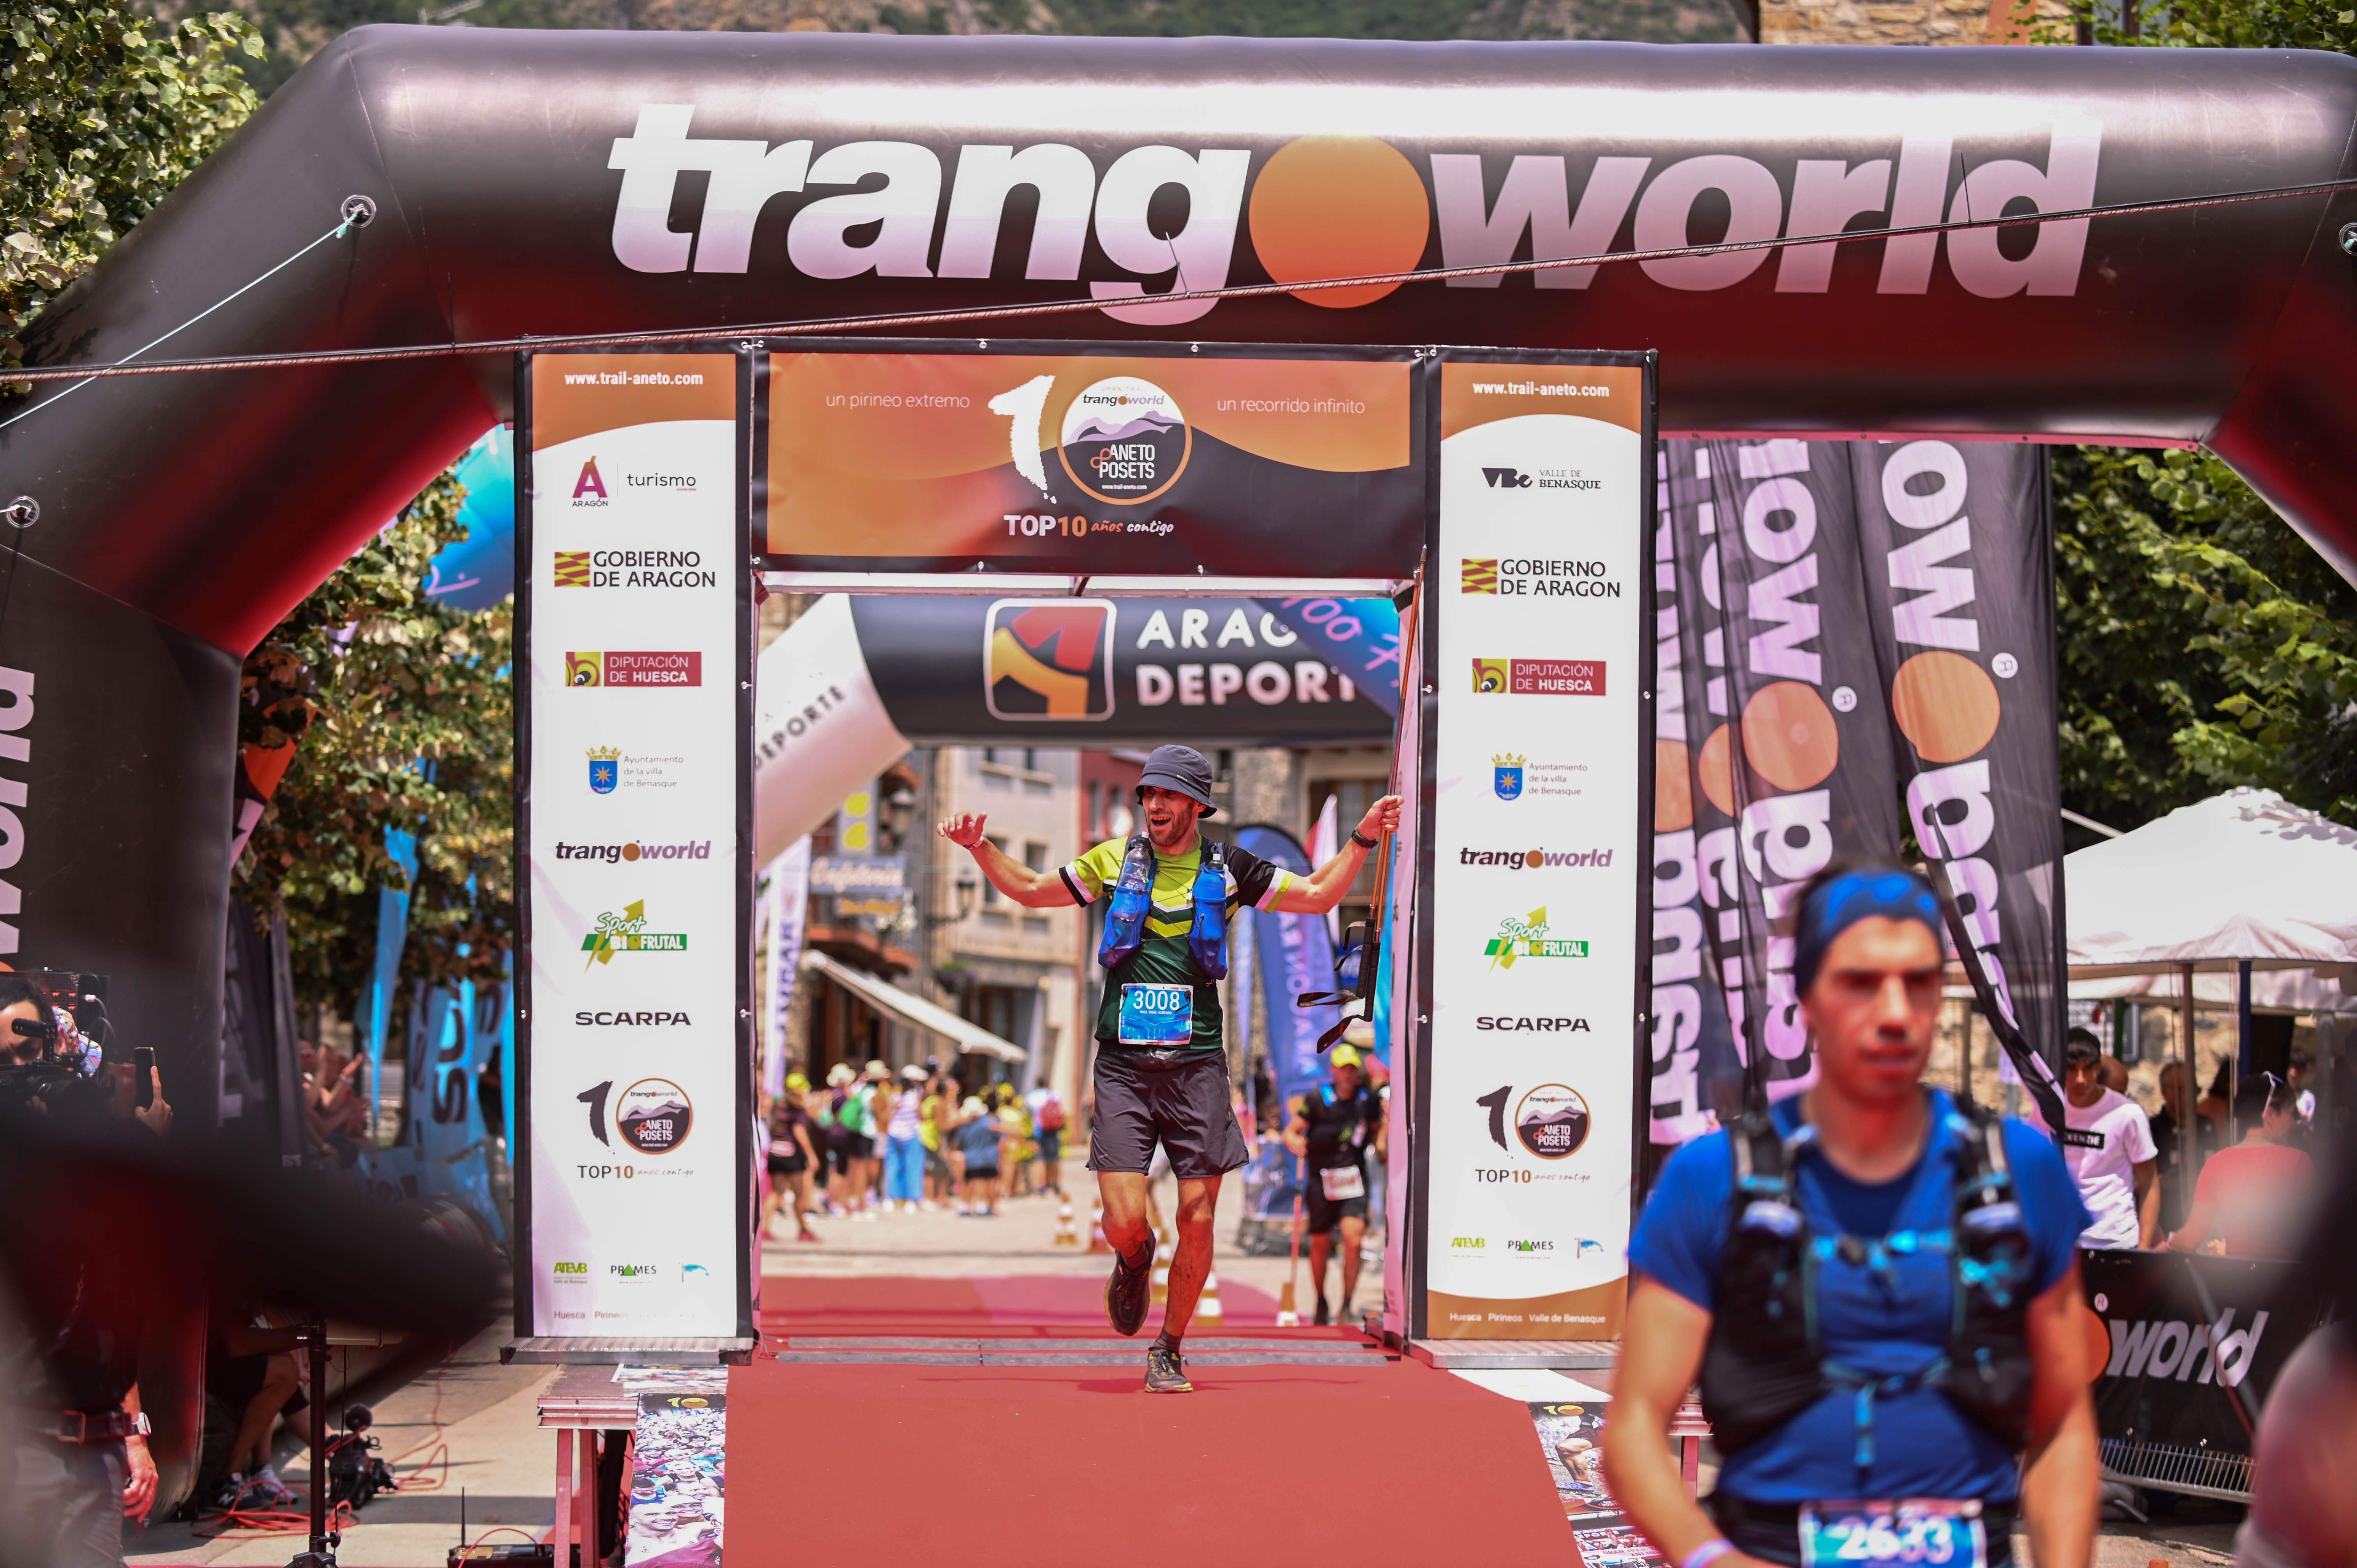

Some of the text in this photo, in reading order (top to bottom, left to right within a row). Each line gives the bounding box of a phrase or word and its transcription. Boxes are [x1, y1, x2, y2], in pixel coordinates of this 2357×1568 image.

[565, 371, 703, 386] www.trail-aneto.com
[1473, 381, 1609, 397] www.trail-aneto.com
[826, 393, 970, 410] un pirineo extremo
[1216, 398, 1365, 413] un recorrido infinito
[1110, 444, 1155, 461] ANETO
[1099, 462, 1155, 479] POSETS
[627, 473, 696, 486] turismo
[1539, 479, 1601, 490] BENASQUE
[572, 498, 608, 507] ARAGÓN
[1091, 520, 1124, 533] años
[1127, 521, 1173, 536] contigo
[594, 551, 700, 567] GOBIERNO
[1501, 559, 1605, 577] GOBIERNO
[594, 571, 715, 587] DE ARAGON
[1501, 579, 1620, 597] DE ARAGON
[610, 655, 688, 668] DIPUTACIÓN
[1516, 663, 1593, 676] DIPUTACIÓN
[610, 671, 688, 682] DE HUESCA
[1516, 678, 1592, 691] DE HUESCA
[624, 756, 683, 764] Ayuntamiento
[1530, 763, 1587, 771] Ayuntamiento
[637, 780, 677, 788] Benasque
[1541, 787, 1581, 796] Benasque
[596, 912, 647, 938] Sport
[1498, 918, 1549, 943] Sport
[1133, 990, 1180, 1010] 3008
[576, 1012, 691, 1025] SCARPA
[1477, 1017, 1590, 1032] SCARPA
[647, 1119, 673, 1130] ANETO
[1544, 1125, 1571, 1135] ANETO
[640, 1130, 673, 1141] POSETS
[1538, 1135, 1570, 1146] POSETS
[1450, 1313, 1605, 1324] Huesca Pirineos Valle de Benasque
